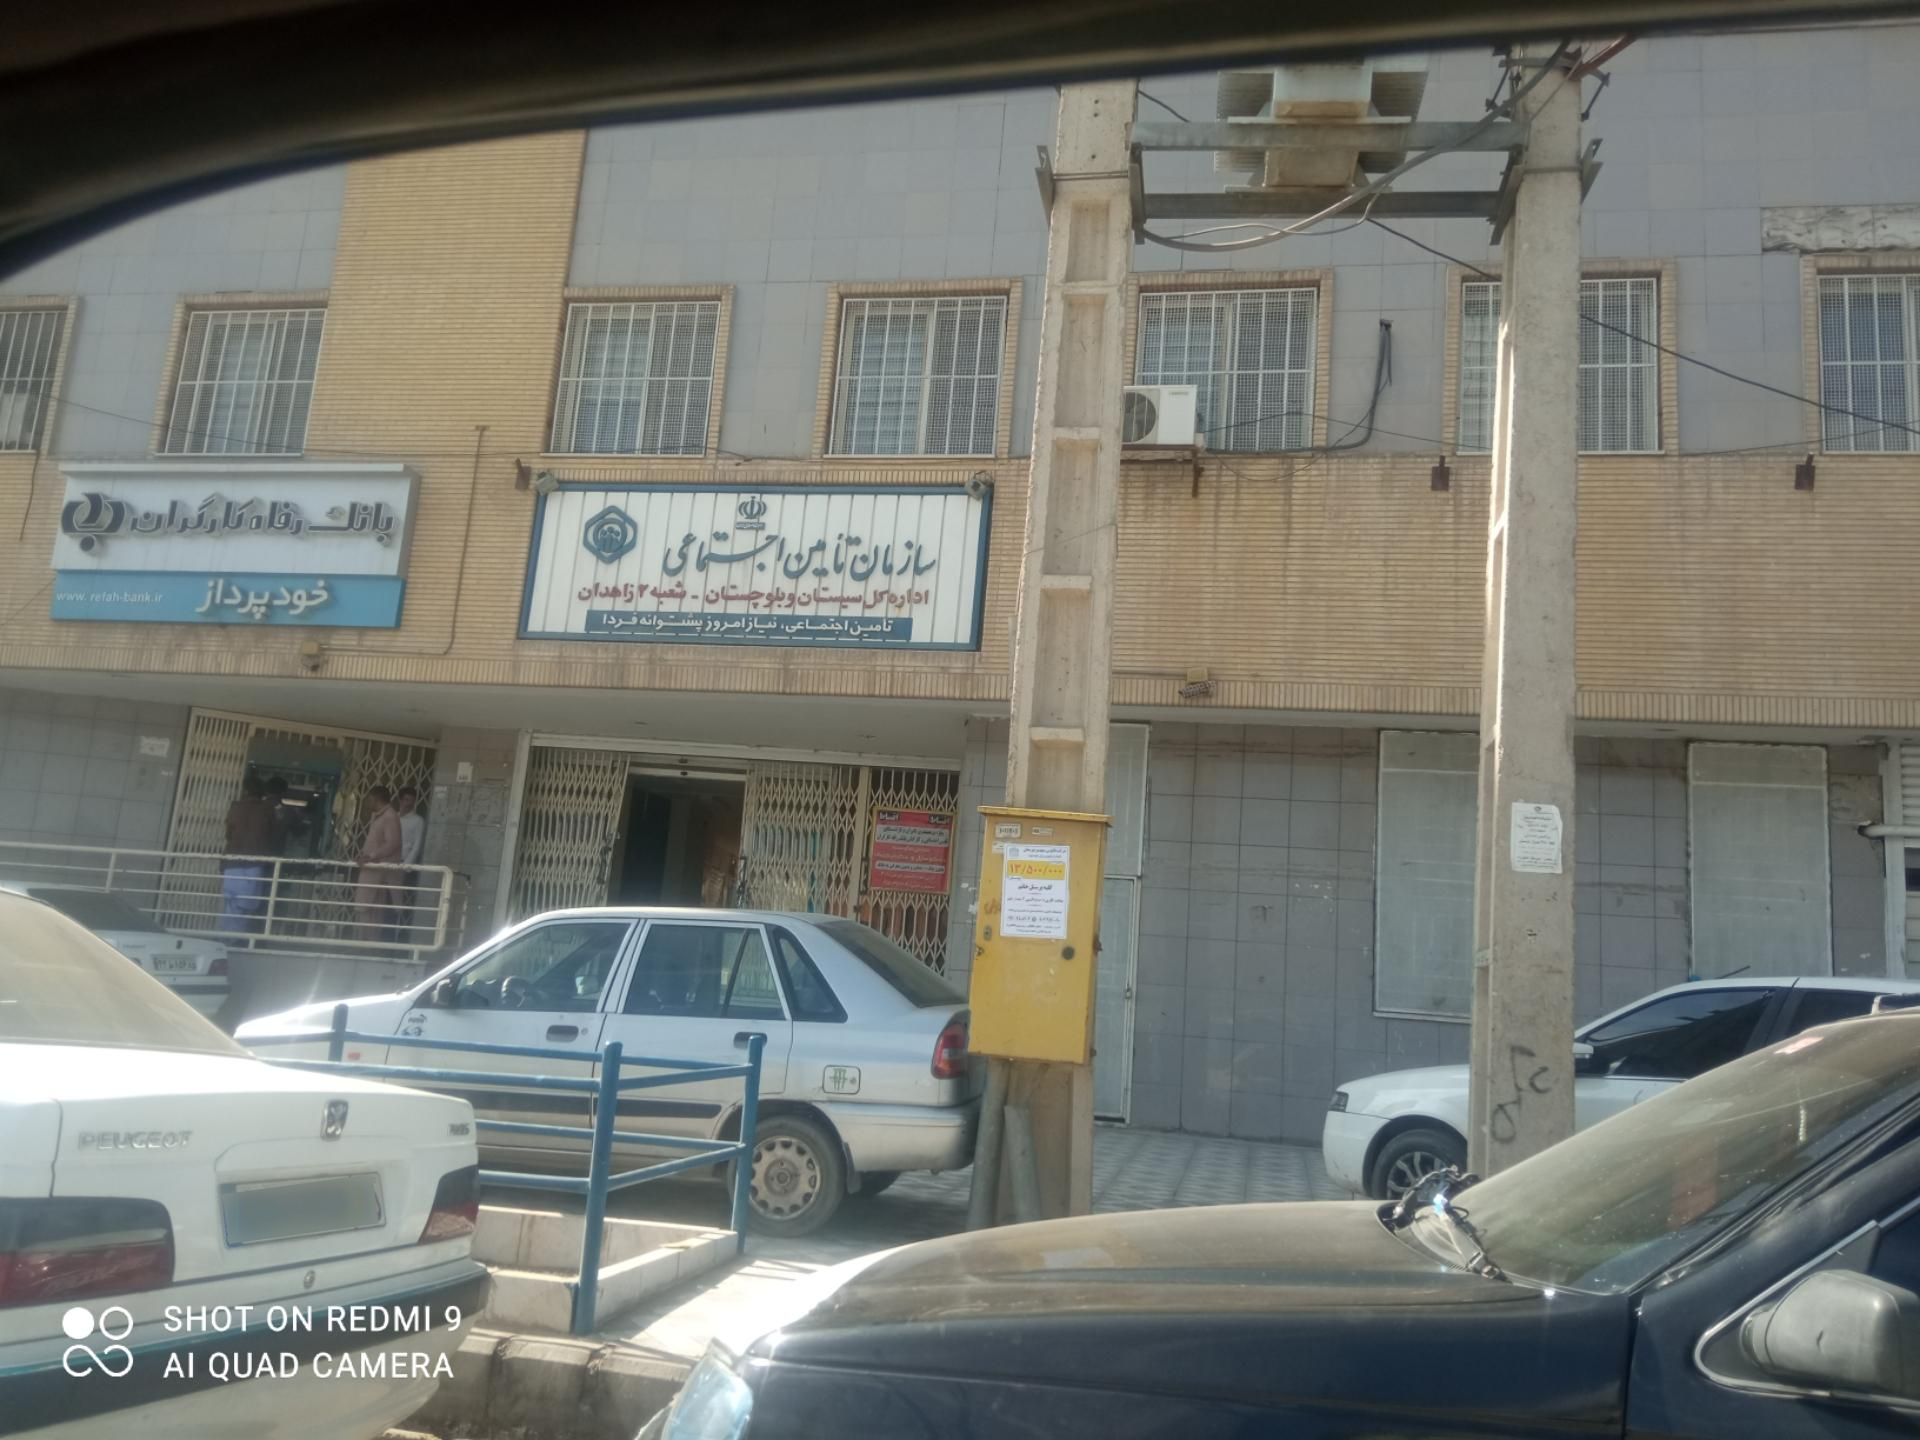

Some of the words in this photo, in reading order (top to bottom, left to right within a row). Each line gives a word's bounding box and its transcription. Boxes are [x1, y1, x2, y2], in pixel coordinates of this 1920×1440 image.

[130, 494, 256, 535] کارگران
[250, 500, 304, 536] رفاه
[307, 500, 394, 543] بانک
[661, 532, 787, 578] اجتماعی
[849, 538, 936, 583] سازمان
[577, 582, 636, 603] زاهدان
[650, 580, 688, 606] شعبه
[797, 586, 863, 609] سیستان
[602, 612, 639, 629] فردا
[638, 613, 704, 634] پشتوانه
[78, 1130, 194, 1151] PEUGEOT
